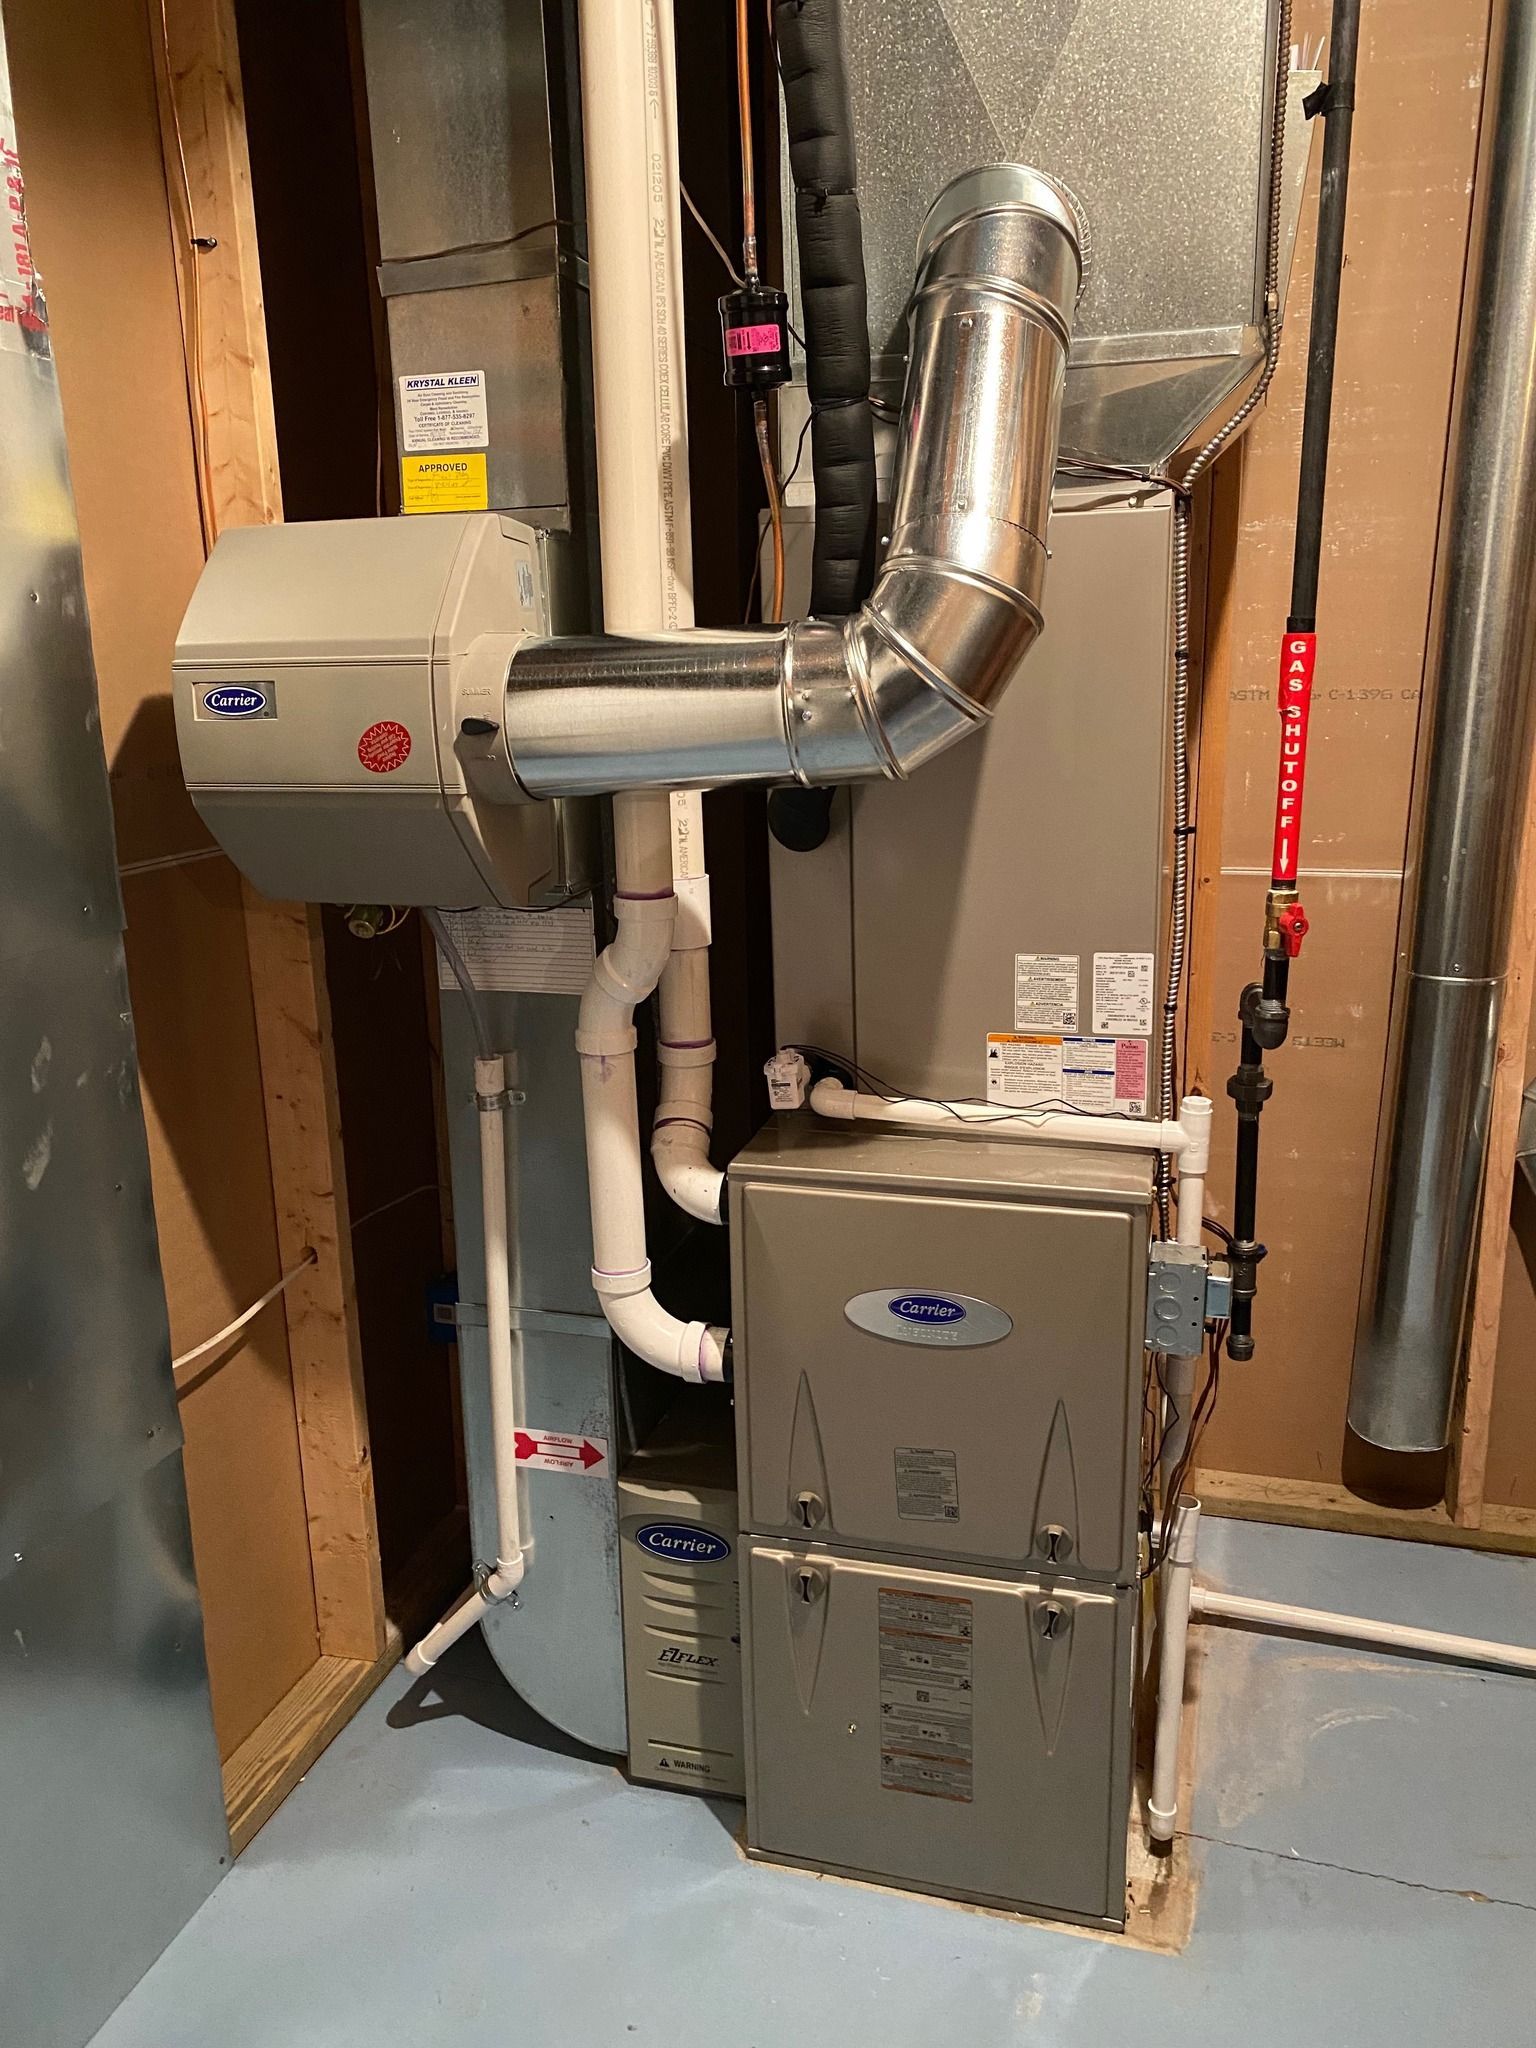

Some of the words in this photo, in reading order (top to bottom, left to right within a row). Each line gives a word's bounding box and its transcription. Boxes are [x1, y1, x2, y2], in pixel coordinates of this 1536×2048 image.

[654, 250, 666, 293] AMERICAN
[656, 295, 666, 308] IPS
[656, 308, 666, 325] SCH
[656, 325, 668, 336] 40
[658, 336, 668, 363] SERIES
[407, 379, 445, 388] KRYSTAL
[447, 376, 477, 385] KLEEN
[658, 363, 669, 384] COEX
[660, 384, 670, 423] CELLULAR
[660, 423, 671, 444] CORE
[662, 445, 672, 461] PVC
[418, 463, 467, 472] APPROVED
[662, 462, 672, 480] DWV
[663, 480, 673, 498] PIPE
[664, 499, 674, 522] ASTM
[1289, 640, 1307, 692] GAS
[211, 693, 257, 707] Carrier
[1329, 688, 1393, 701] C-1396
[1281, 705, 1302, 828] SHUTOFF
[900, 1301, 955, 1317] Carrier
[543, 1435, 573, 1444] AIRFLOW
[543, 1458, 574, 1468] AIRFLOW
[649, 1532, 716, 1554] Carrier
[674, 1760, 711, 1773] WARNING
